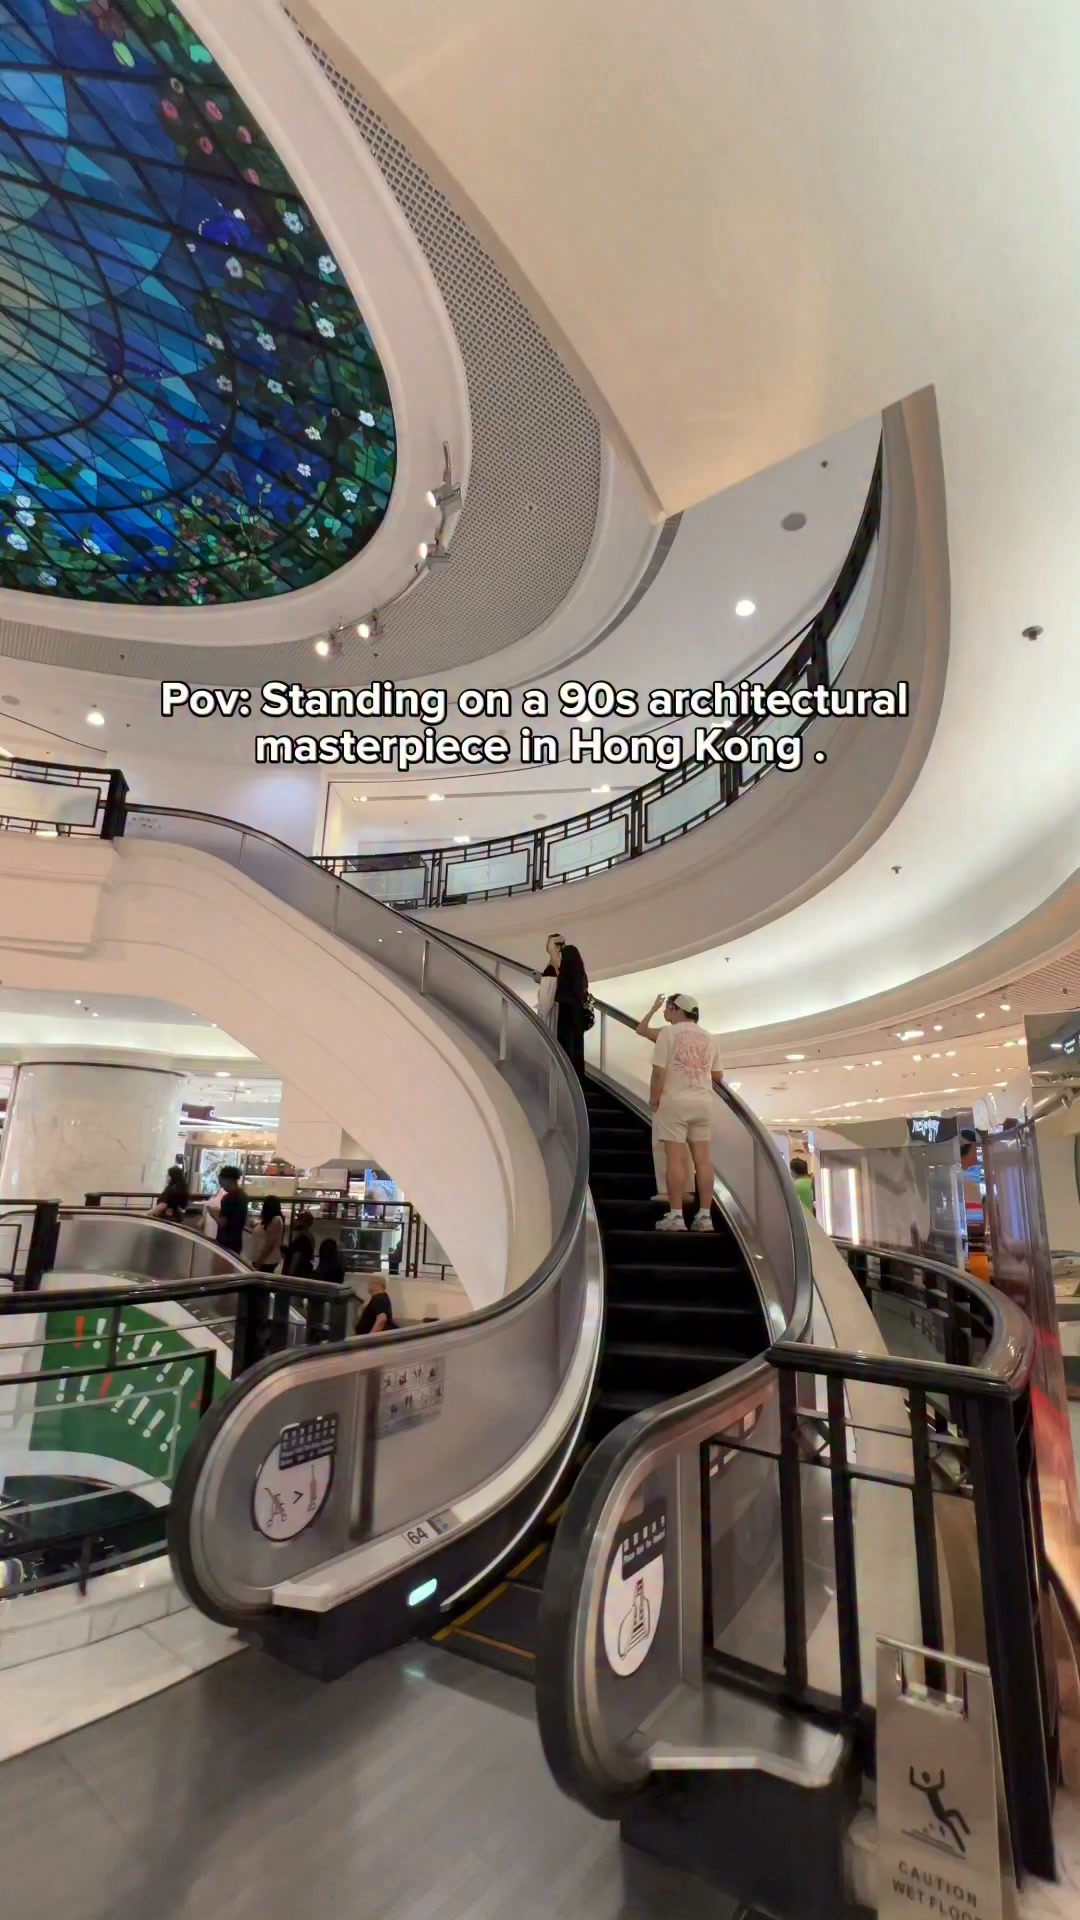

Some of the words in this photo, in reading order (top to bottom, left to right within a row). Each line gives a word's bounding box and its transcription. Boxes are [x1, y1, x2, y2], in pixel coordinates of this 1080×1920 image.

[407, 1527, 429, 1544] 64
[892, 1877, 923, 1904] WET
[898, 1861, 977, 1908] CAUTION
